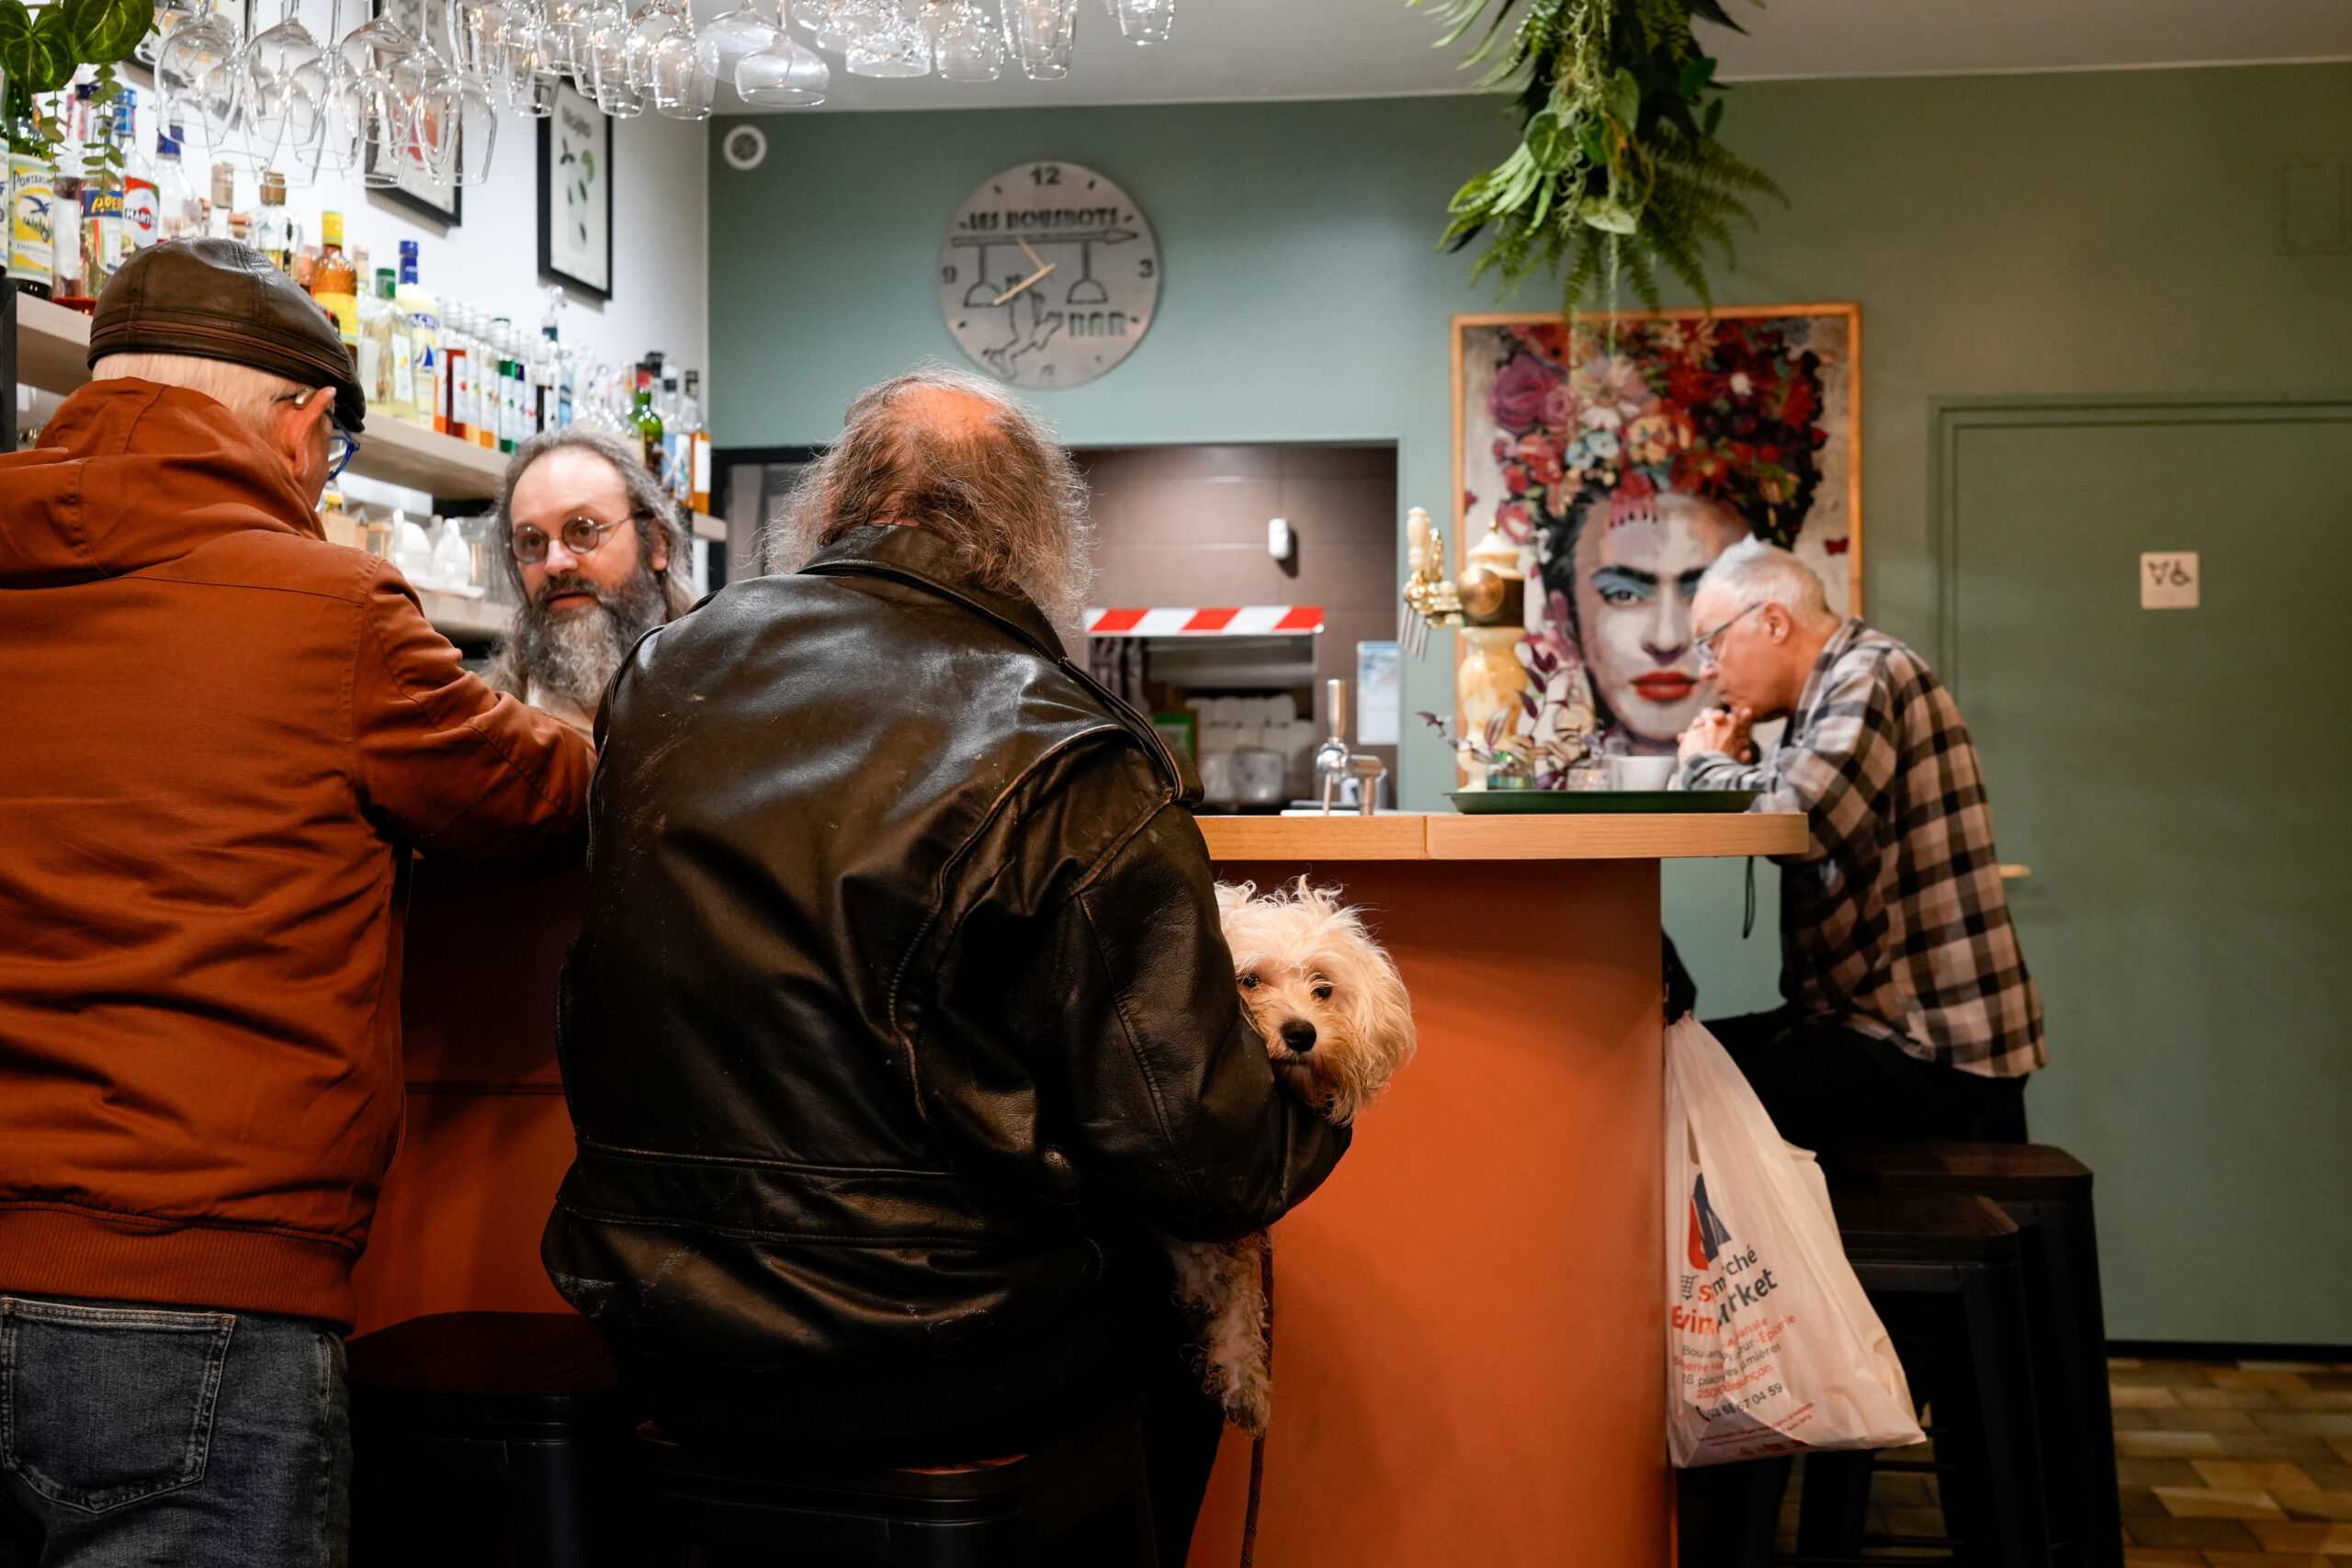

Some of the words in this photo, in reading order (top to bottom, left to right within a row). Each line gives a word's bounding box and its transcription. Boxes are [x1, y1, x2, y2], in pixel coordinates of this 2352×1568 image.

[1030, 166, 1061, 186] 12
[1138, 259, 1154, 278] 3
[1767, 1382, 1782, 1396] 59
